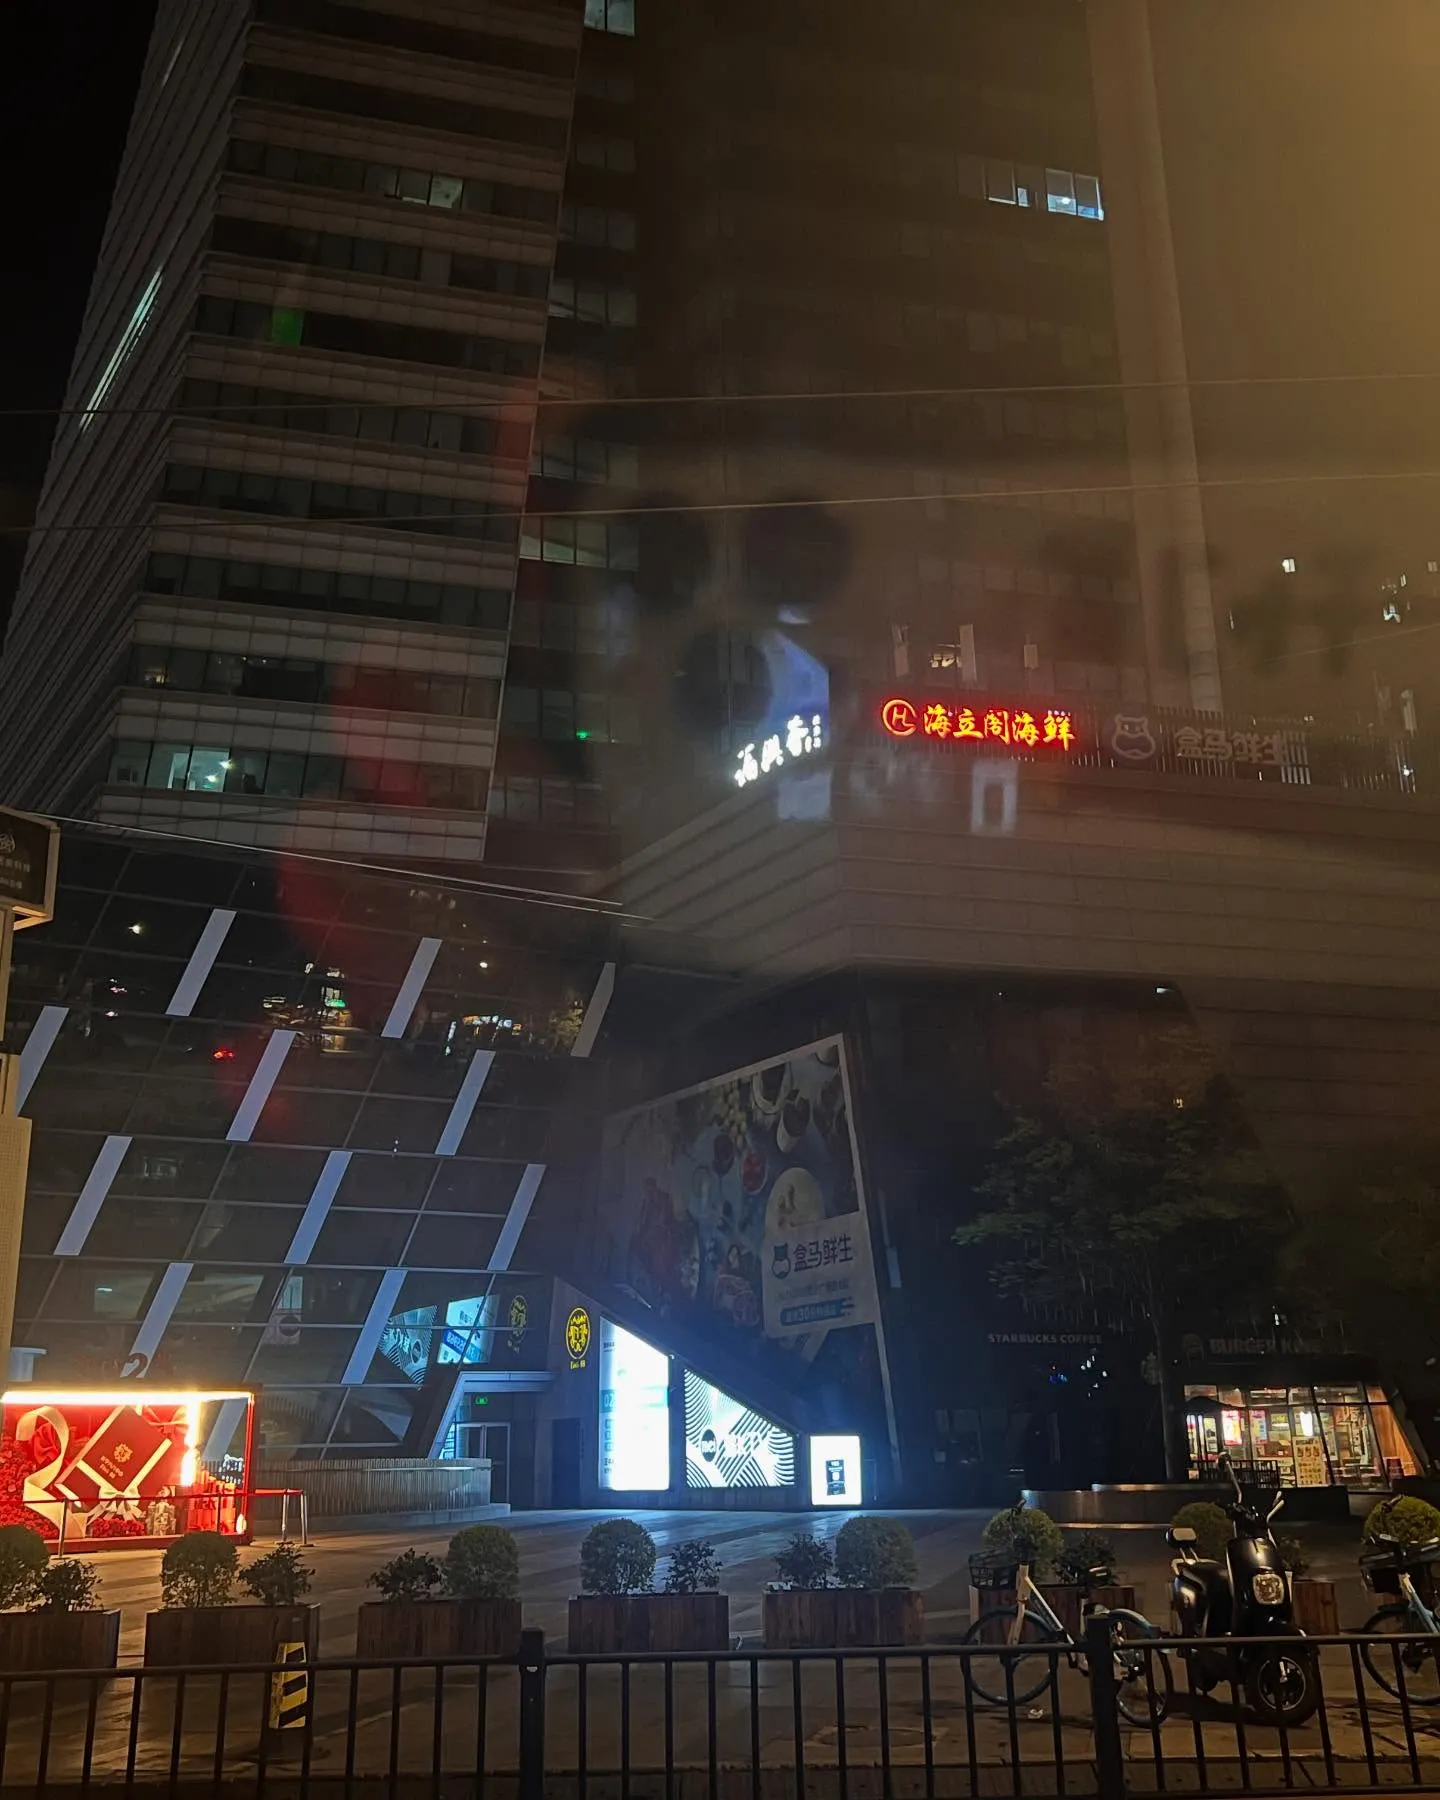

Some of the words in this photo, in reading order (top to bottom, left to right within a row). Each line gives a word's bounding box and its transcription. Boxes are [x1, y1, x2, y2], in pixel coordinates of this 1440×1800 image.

[923, 703, 1075, 751] 海立阁海鲜
[793, 1233, 854, 1273] 盒马鲜生
[988, 1333, 1057, 1344] STARBUCKS
[1060, 1333, 1103, 1344] COFFEE
[1207, 1337, 1276, 1355] BURGER
